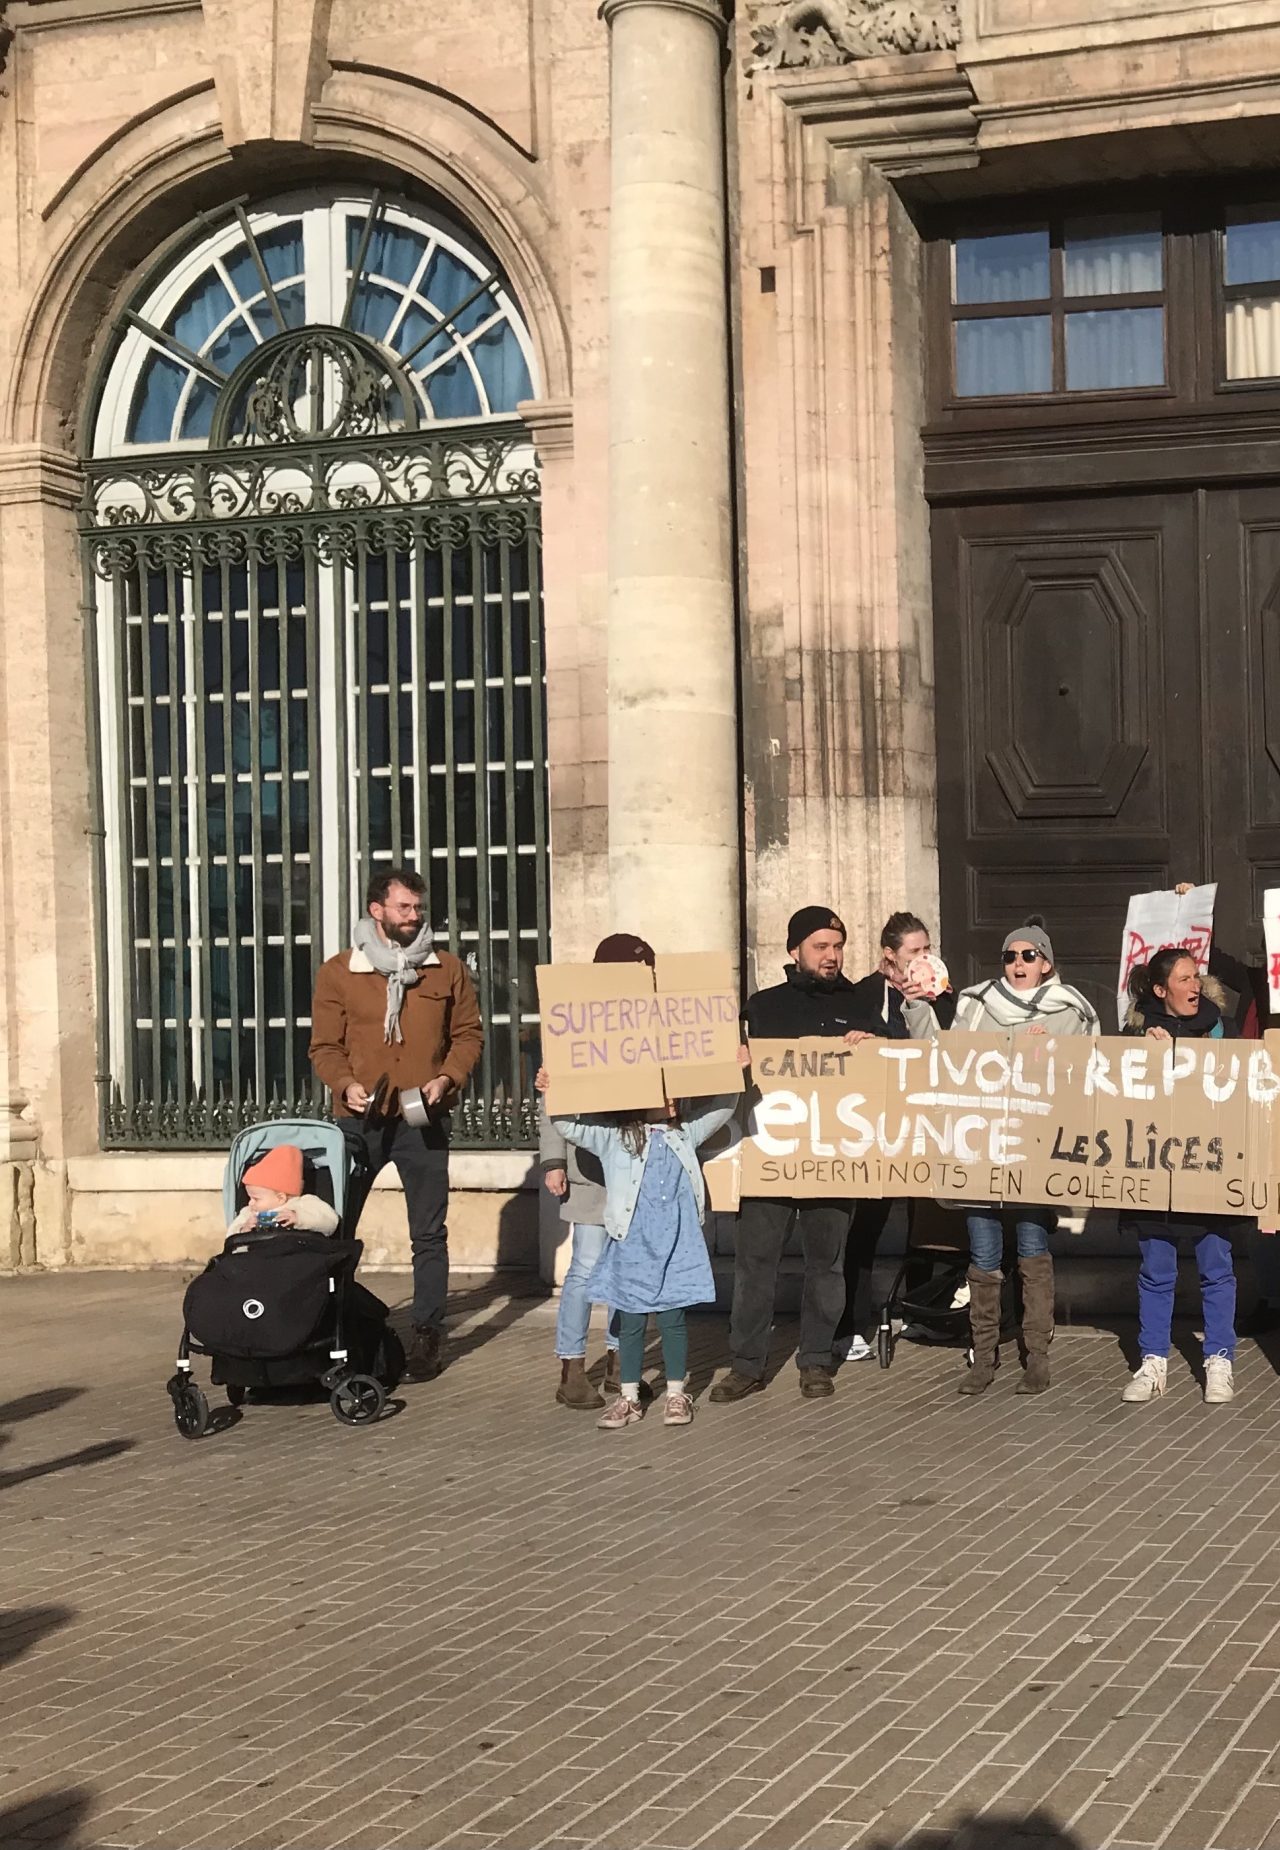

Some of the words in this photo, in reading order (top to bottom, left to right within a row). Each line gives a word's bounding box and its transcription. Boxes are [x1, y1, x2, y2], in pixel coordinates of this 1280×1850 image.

[546, 995, 738, 1037] SUPERPARENTS
[570, 1038, 609, 1068] EN
[619, 1030, 715, 1064] GALÈRE
[1050, 1126, 1112, 1167] LES
[989, 1167, 1023, 1197] EN
[1045, 1170, 1152, 1205] COLÈRE
